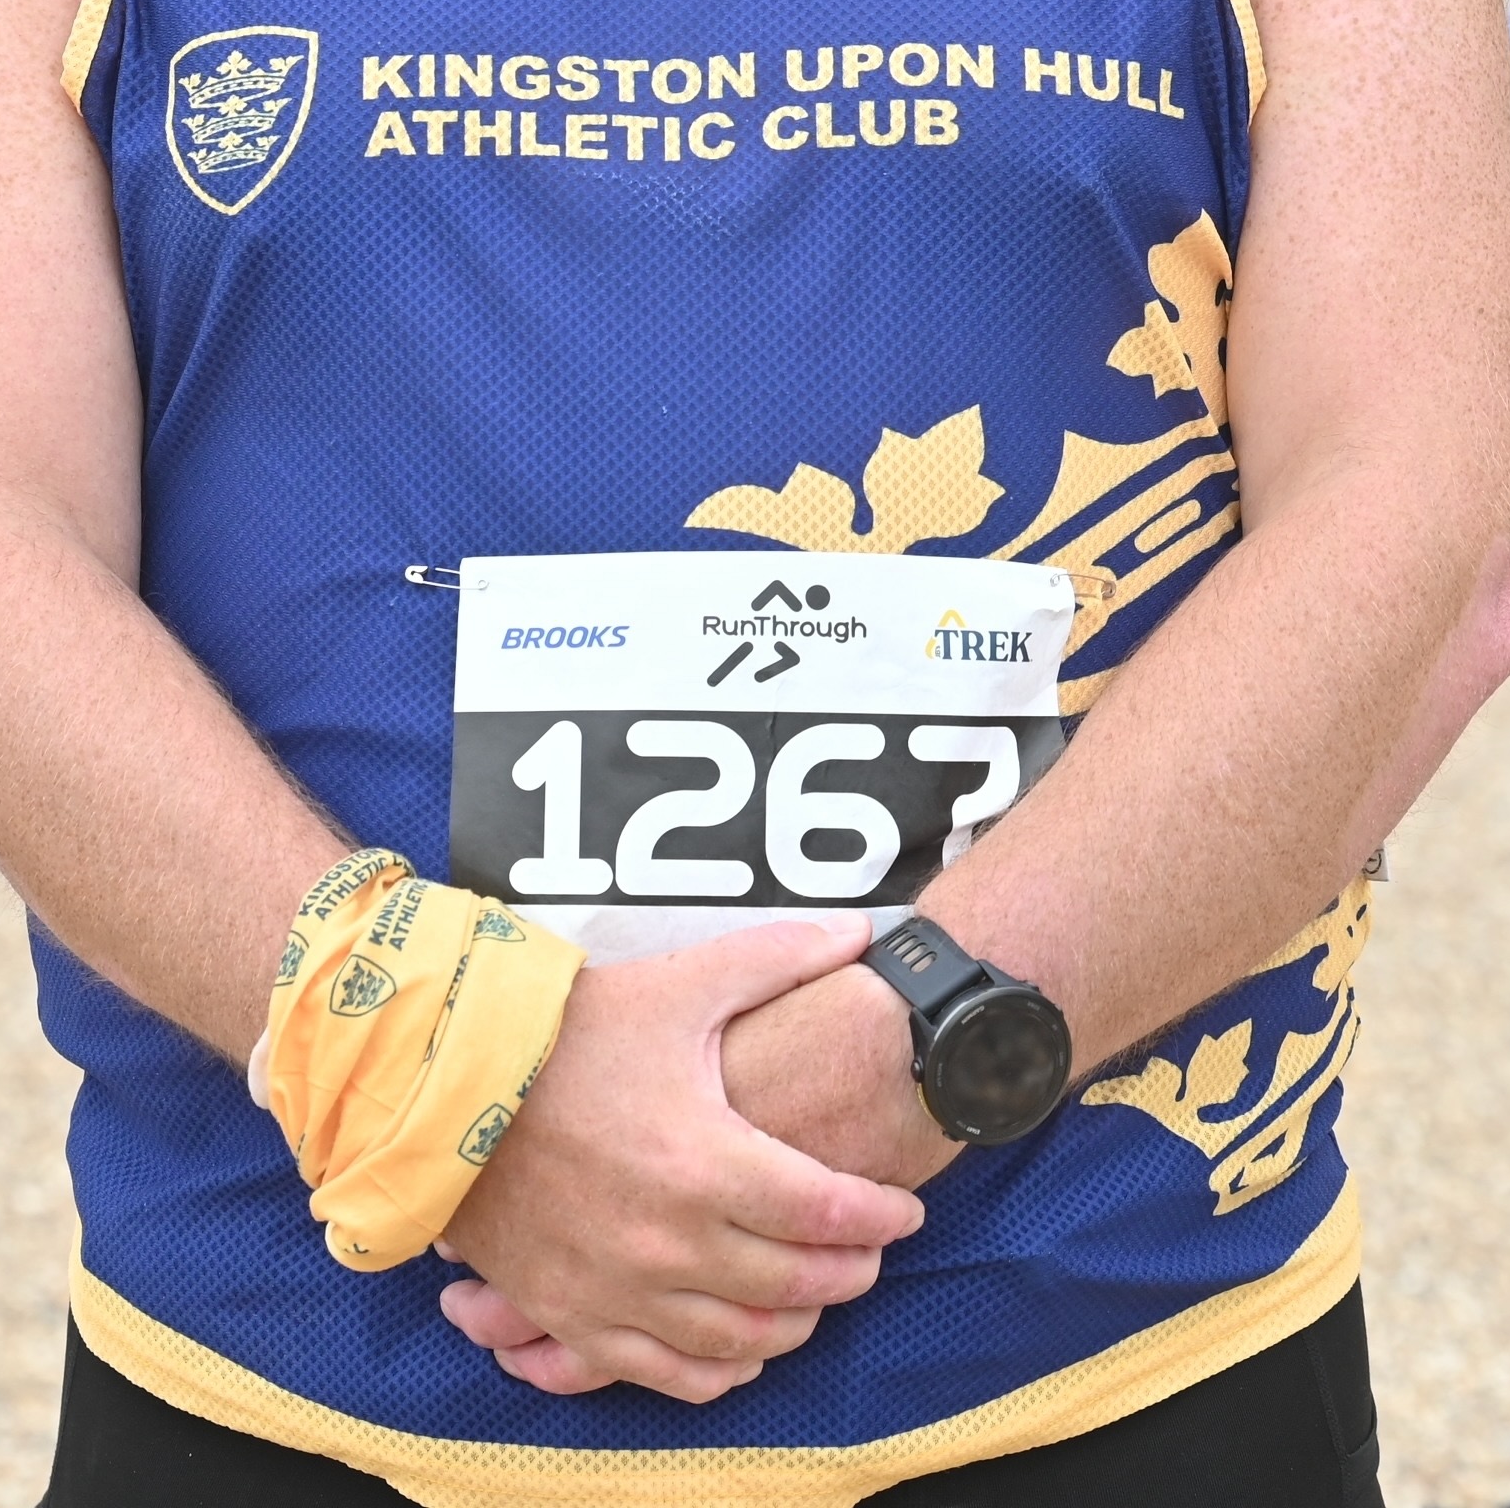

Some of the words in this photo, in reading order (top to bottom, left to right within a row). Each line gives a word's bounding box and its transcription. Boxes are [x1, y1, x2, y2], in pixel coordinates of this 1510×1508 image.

[362, 51, 755, 104] KINGSTON
[786, 43, 994, 92] UPON
[1024, 47, 1185, 120] HULL
[364, 110, 736, 161] ATHLETIC
[762, 99, 960, 150] CLUB
[501, 625, 630, 650] BROOKS
[702, 615, 867, 643] RunThrough
[934, 629, 1032, 663] TREK
[509, 720, 1021, 899] 1267
